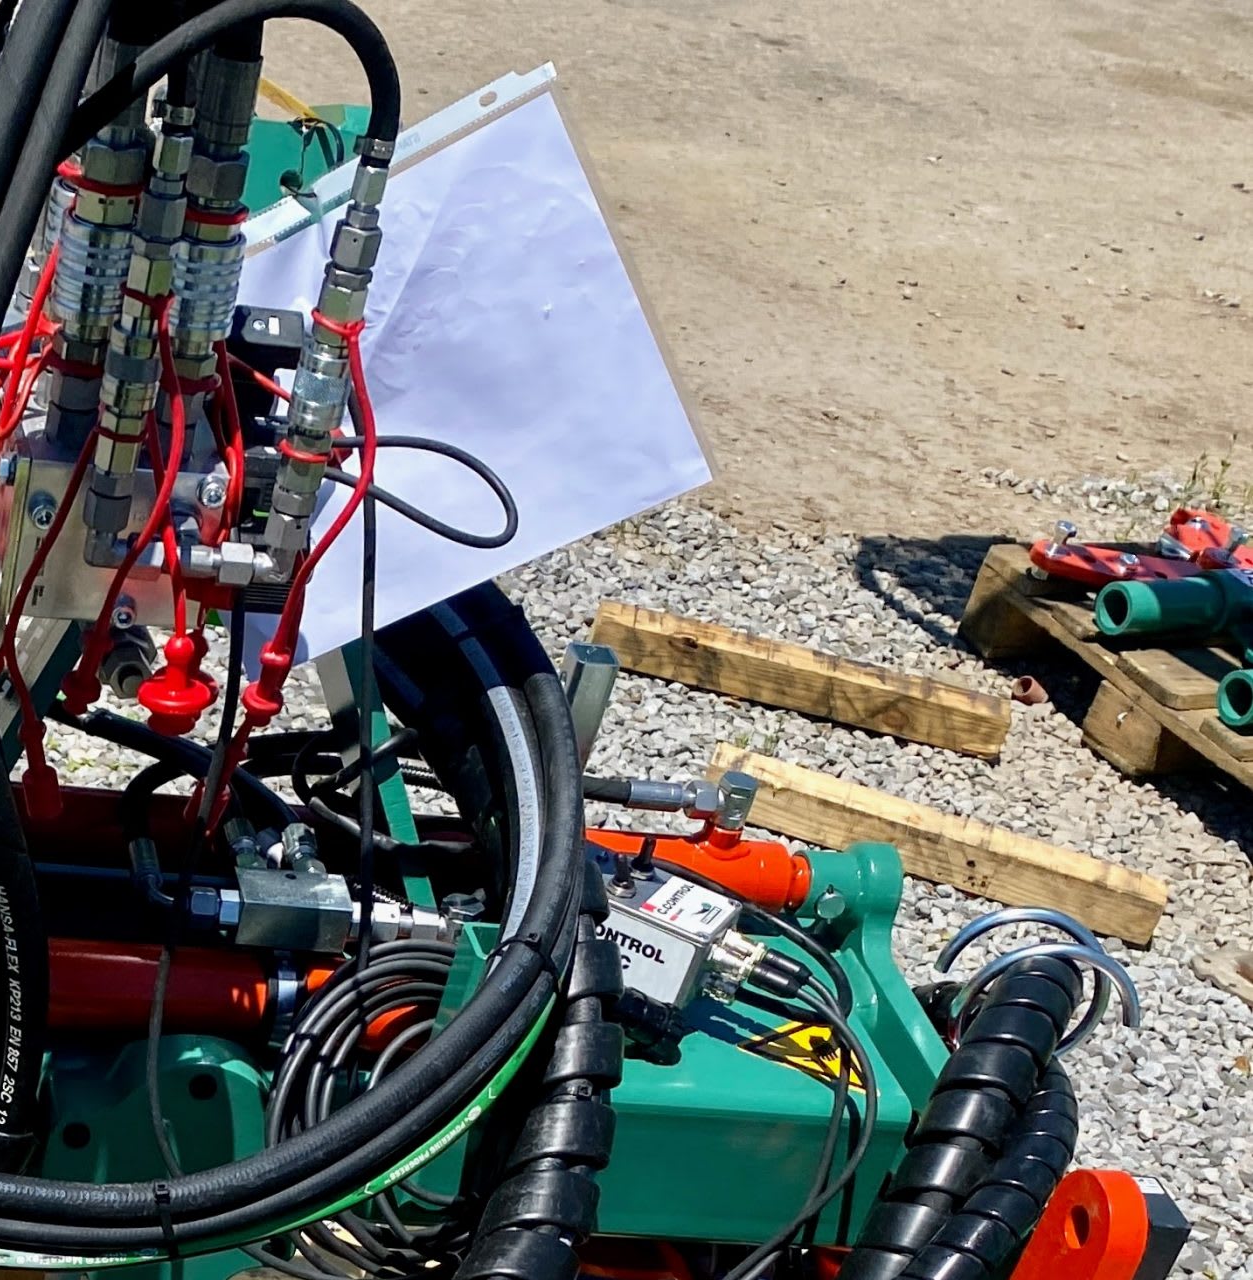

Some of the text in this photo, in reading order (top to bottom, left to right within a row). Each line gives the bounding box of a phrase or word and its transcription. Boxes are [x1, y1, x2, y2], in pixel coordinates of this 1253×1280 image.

[595, 923, 665, 964] ONTROL
[8, 978, 22, 1021] KP213
[8, 1025, 22, 1047] EN
[6, 1047, 20, 1072] 857
[0, 1074, 15, 1104] 2SC
[429, 1121, 465, 1153] POWERING
